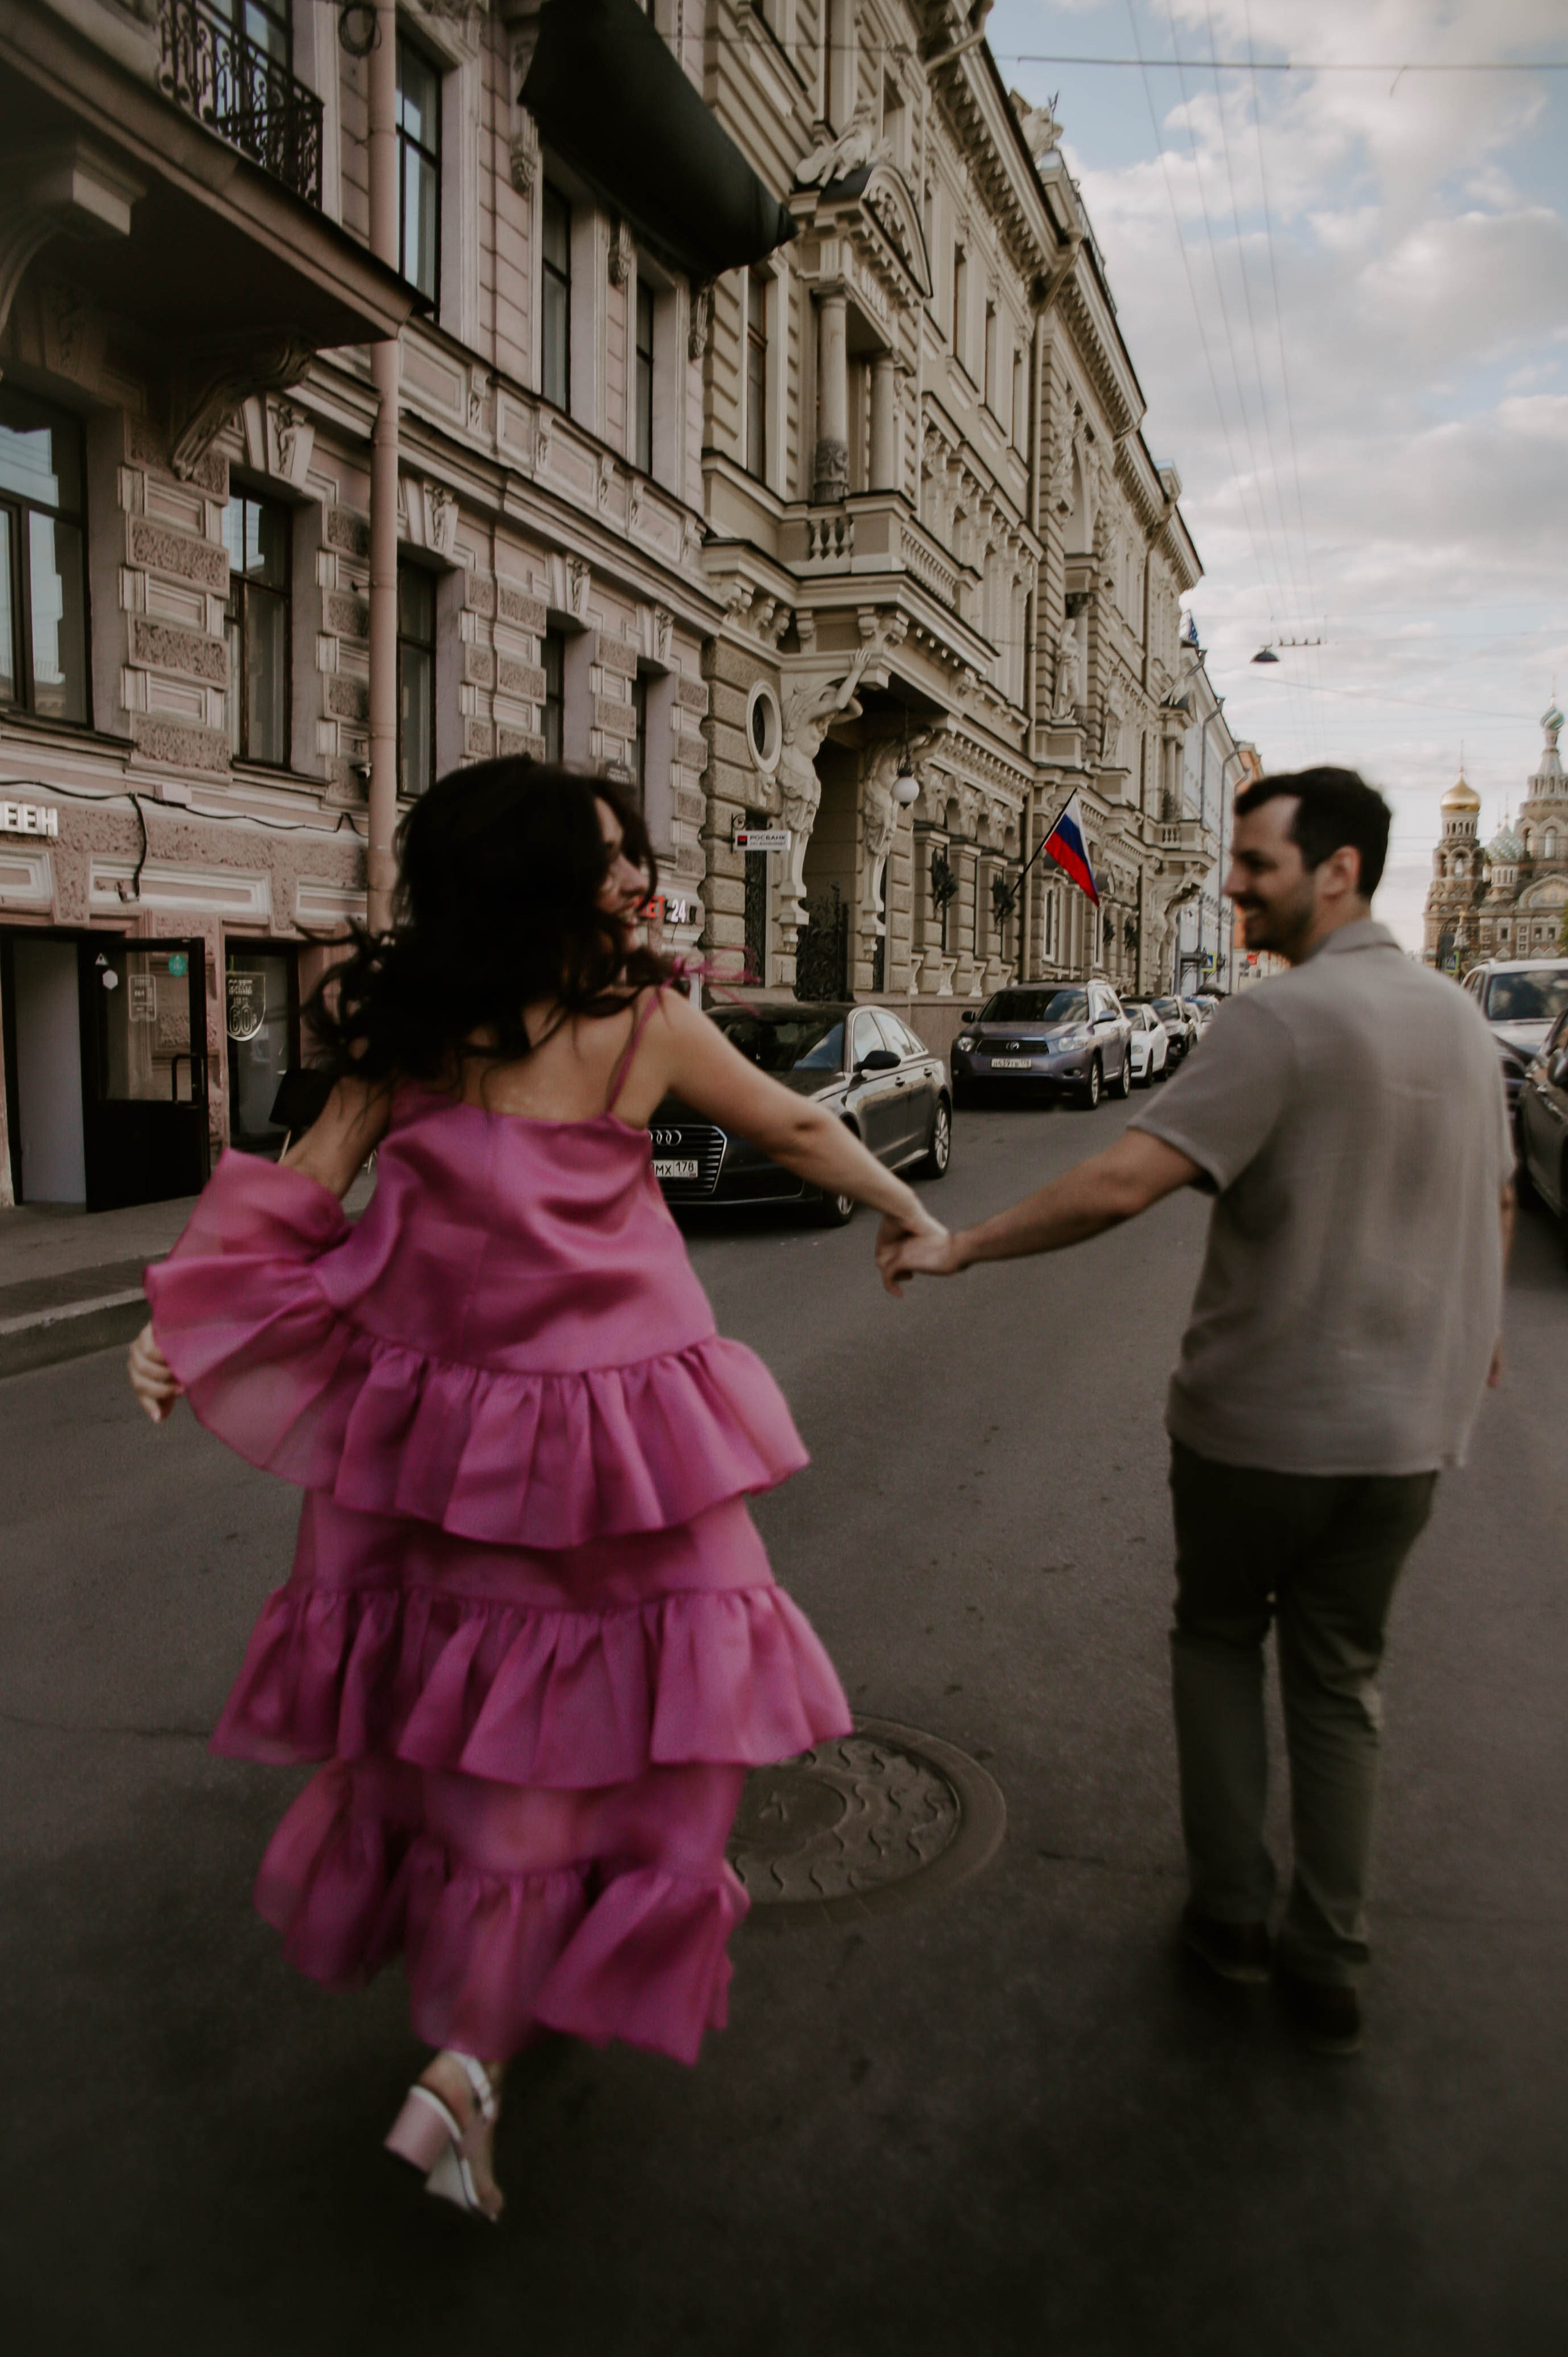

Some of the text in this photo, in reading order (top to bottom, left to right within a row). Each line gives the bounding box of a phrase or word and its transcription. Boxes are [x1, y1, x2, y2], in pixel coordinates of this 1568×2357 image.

[671, 899, 686, 924] 24
[652, 1161, 695, 1175] МХ 178
